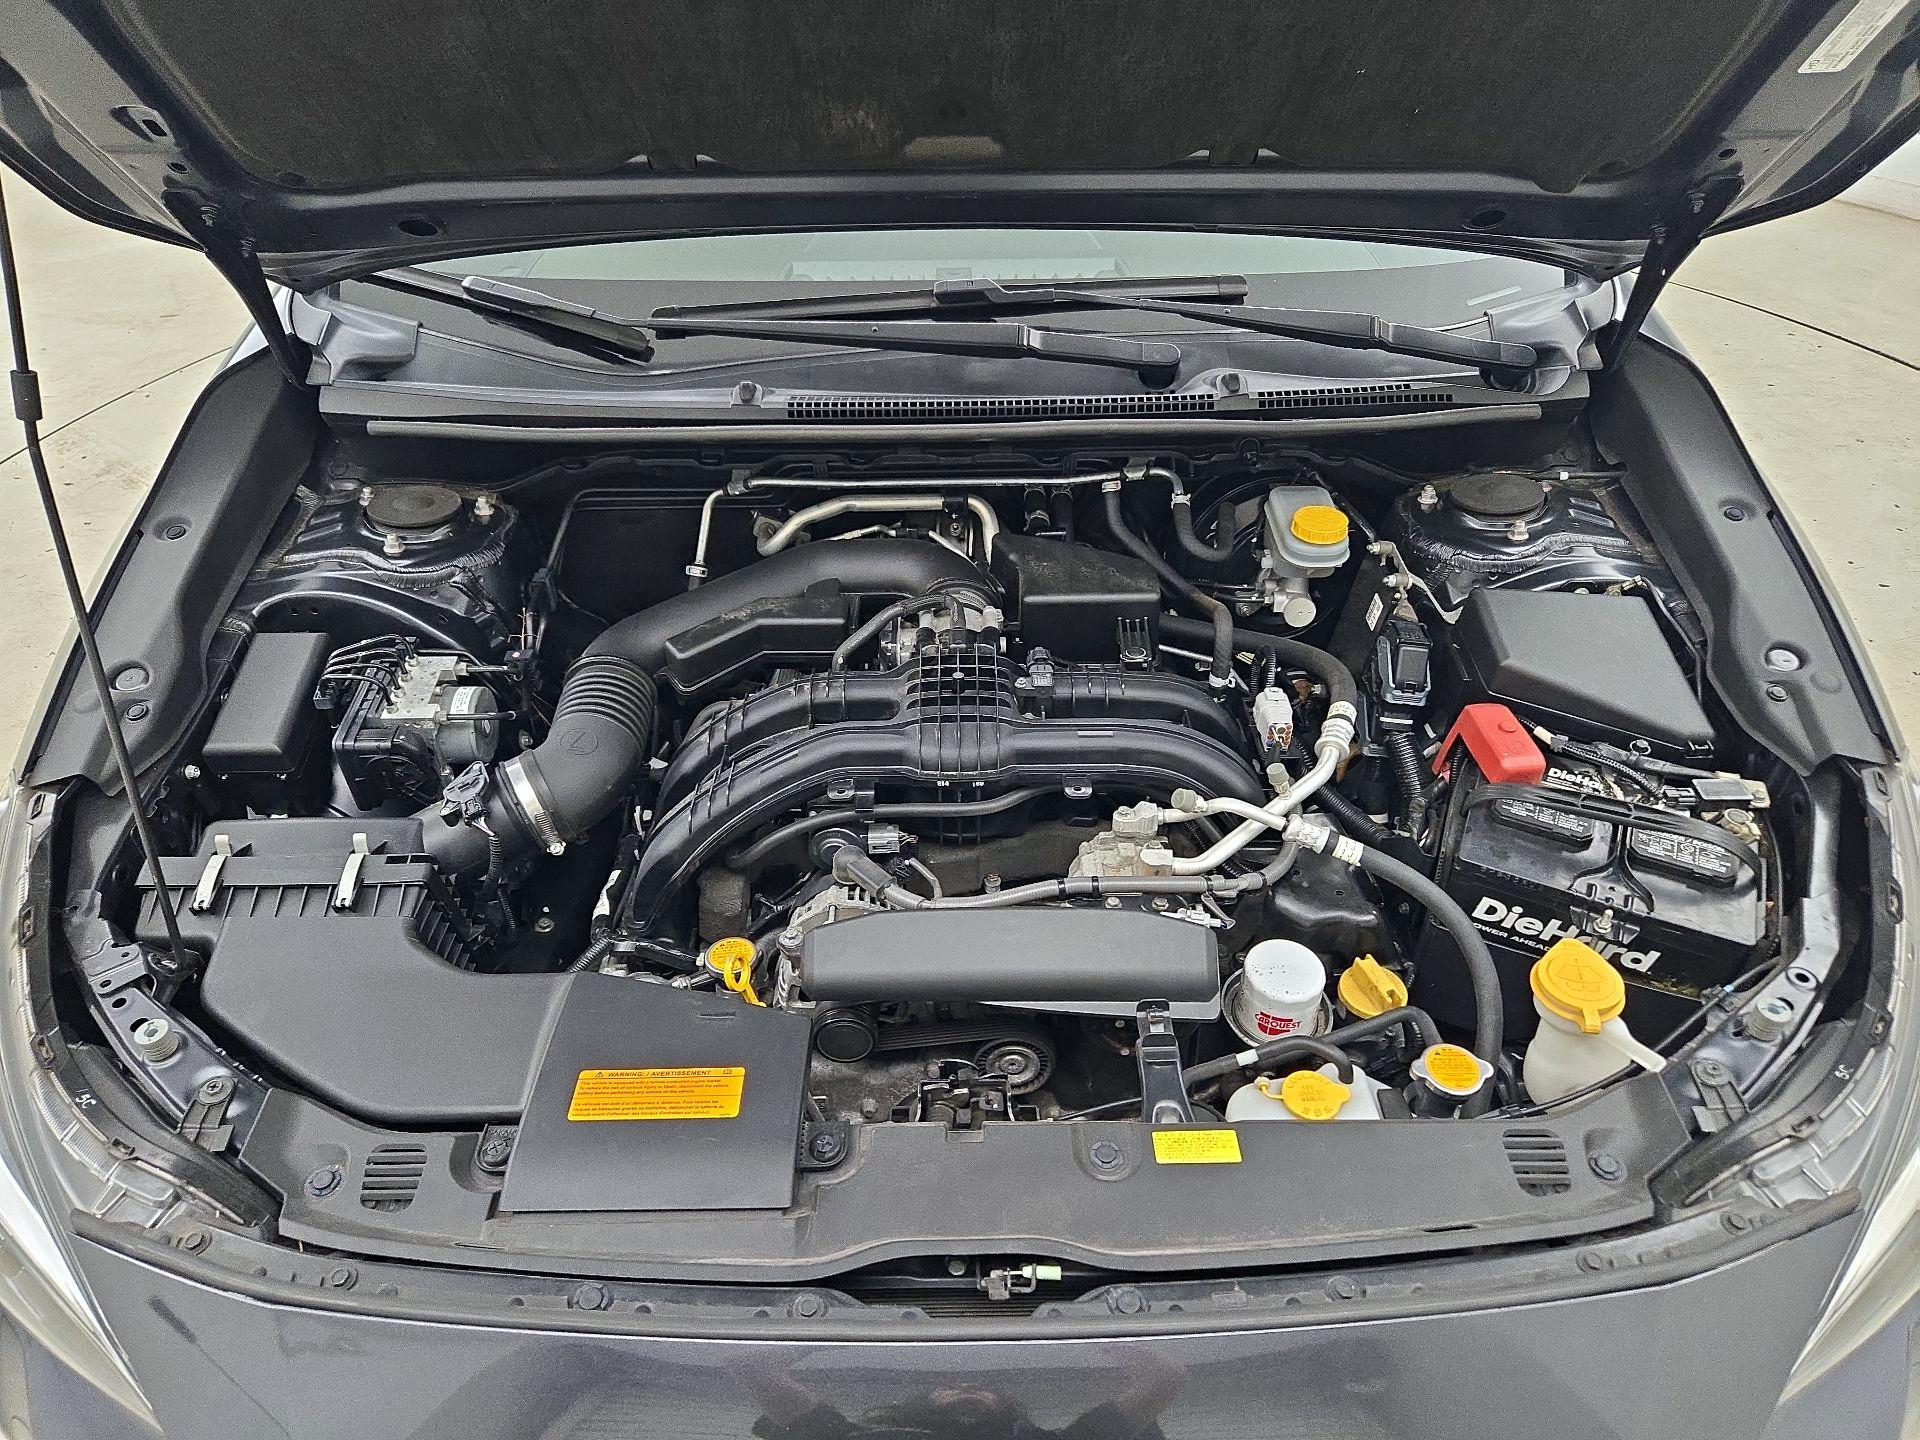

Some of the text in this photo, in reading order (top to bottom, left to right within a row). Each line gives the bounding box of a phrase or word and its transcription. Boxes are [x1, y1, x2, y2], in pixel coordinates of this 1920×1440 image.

[1472, 922, 1508, 938] OWER
[1510, 935, 1551, 952] AHEAD
[1254, 1013, 1303, 1030] CARQUEST
